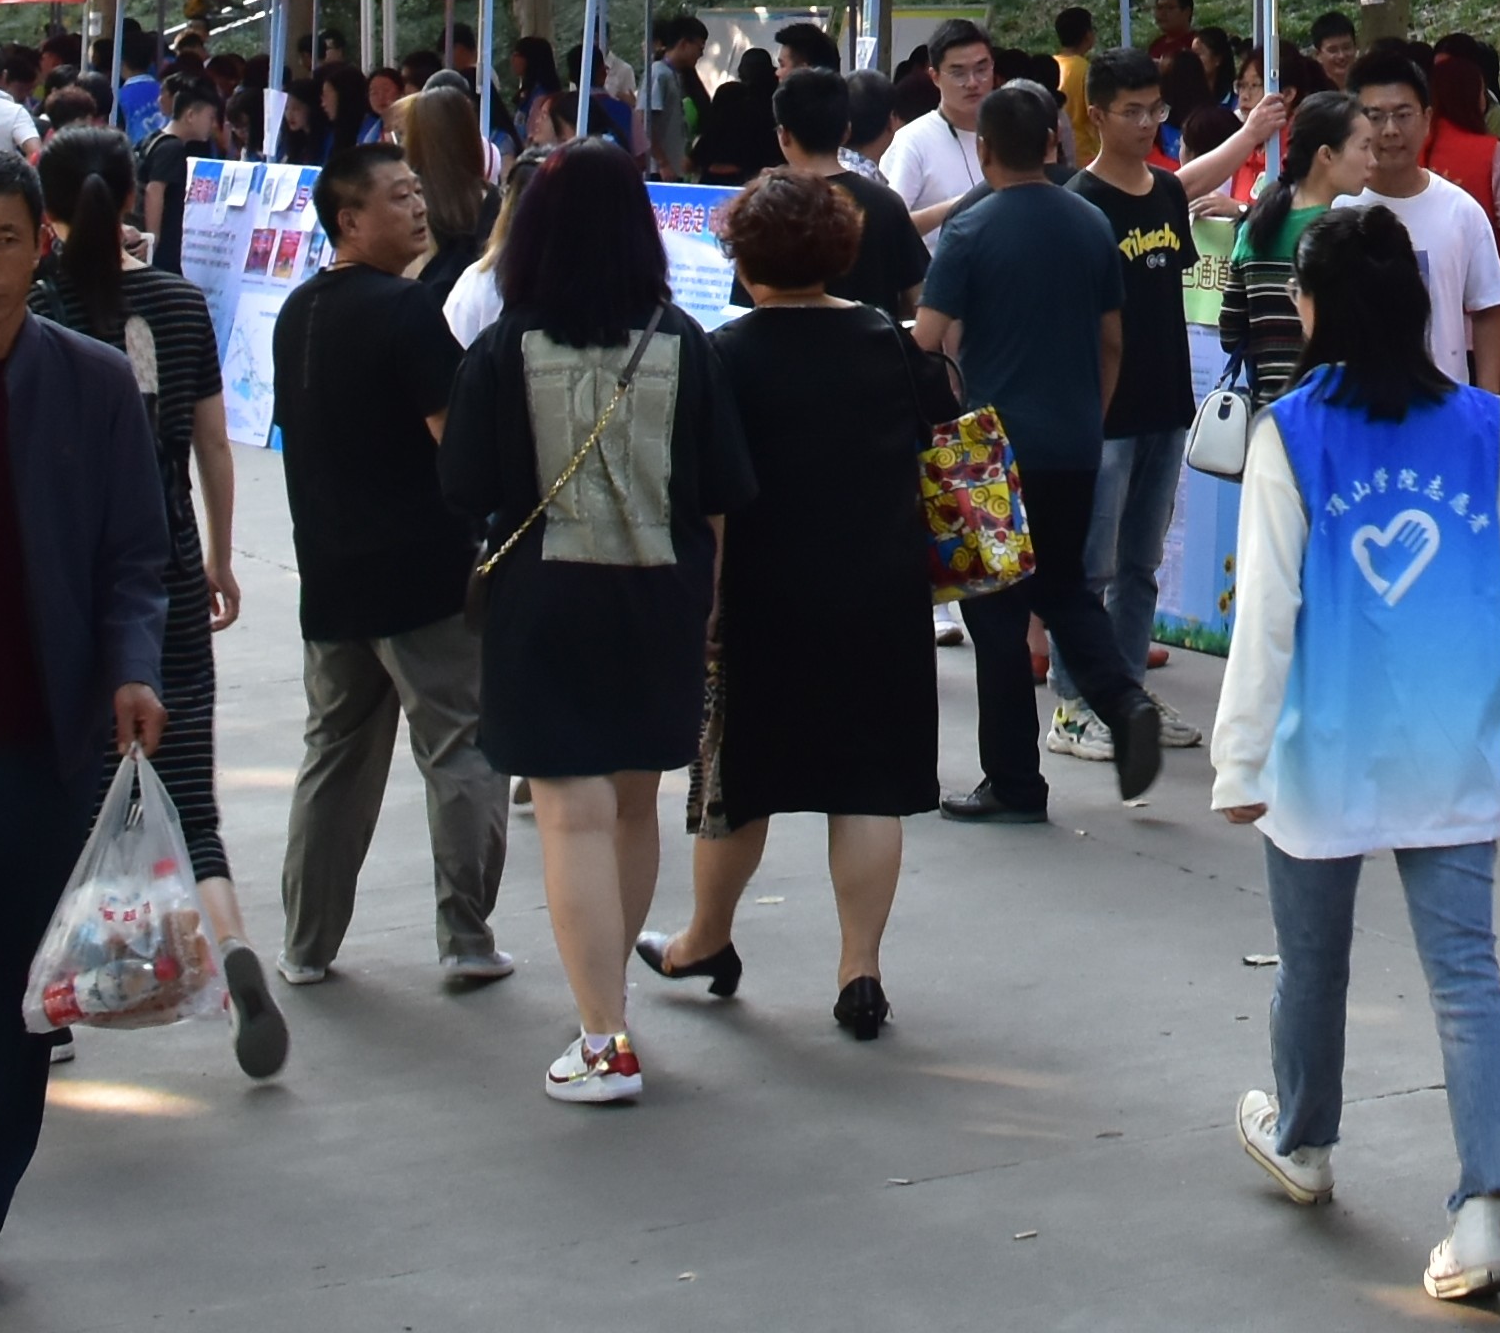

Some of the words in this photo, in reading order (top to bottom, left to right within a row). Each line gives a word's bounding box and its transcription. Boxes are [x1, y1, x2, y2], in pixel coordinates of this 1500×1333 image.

[1319, 467, 1491, 536] 顶山学院志愿者
